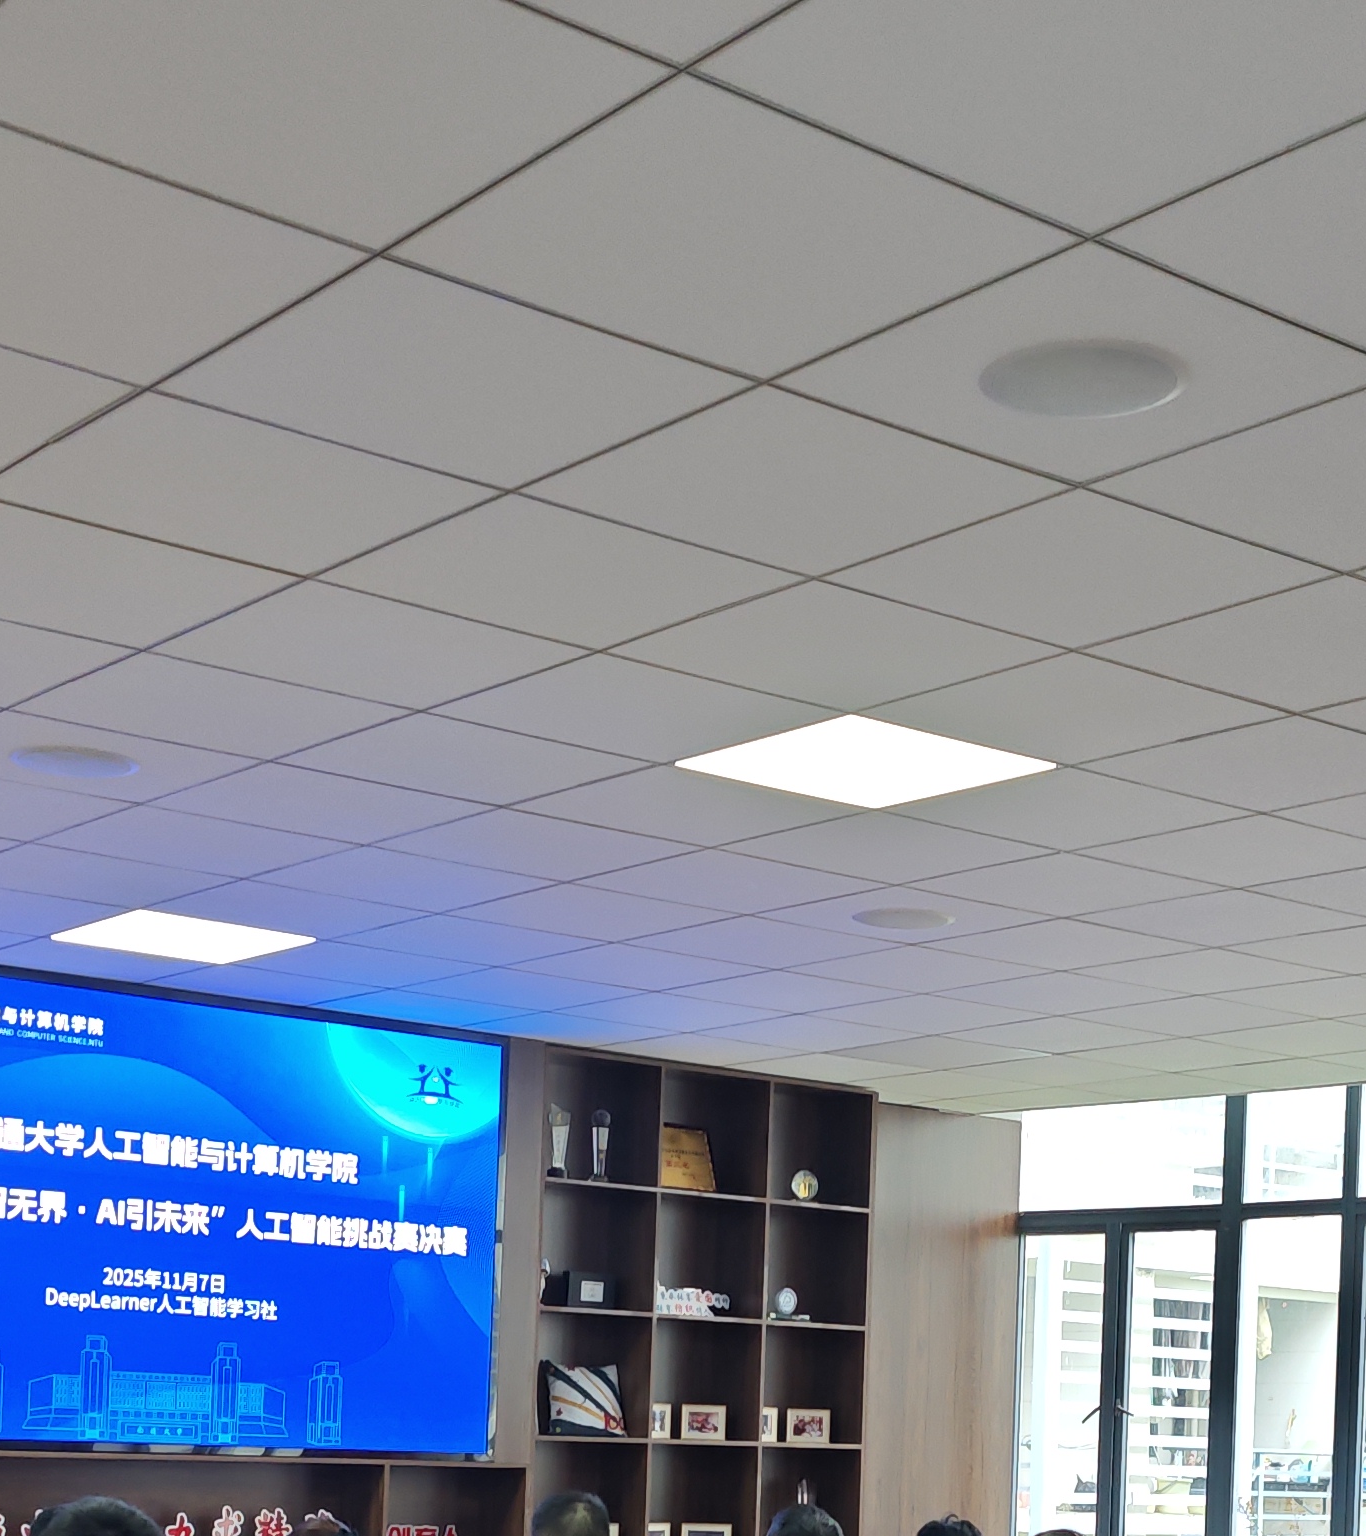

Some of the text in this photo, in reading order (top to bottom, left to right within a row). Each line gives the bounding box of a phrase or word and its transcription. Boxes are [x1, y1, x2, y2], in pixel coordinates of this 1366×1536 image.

[102, 1266, 225, 1294] 2025年11月7日
[45, 1287, 278, 1321] DeepLearner人工智能学习社
